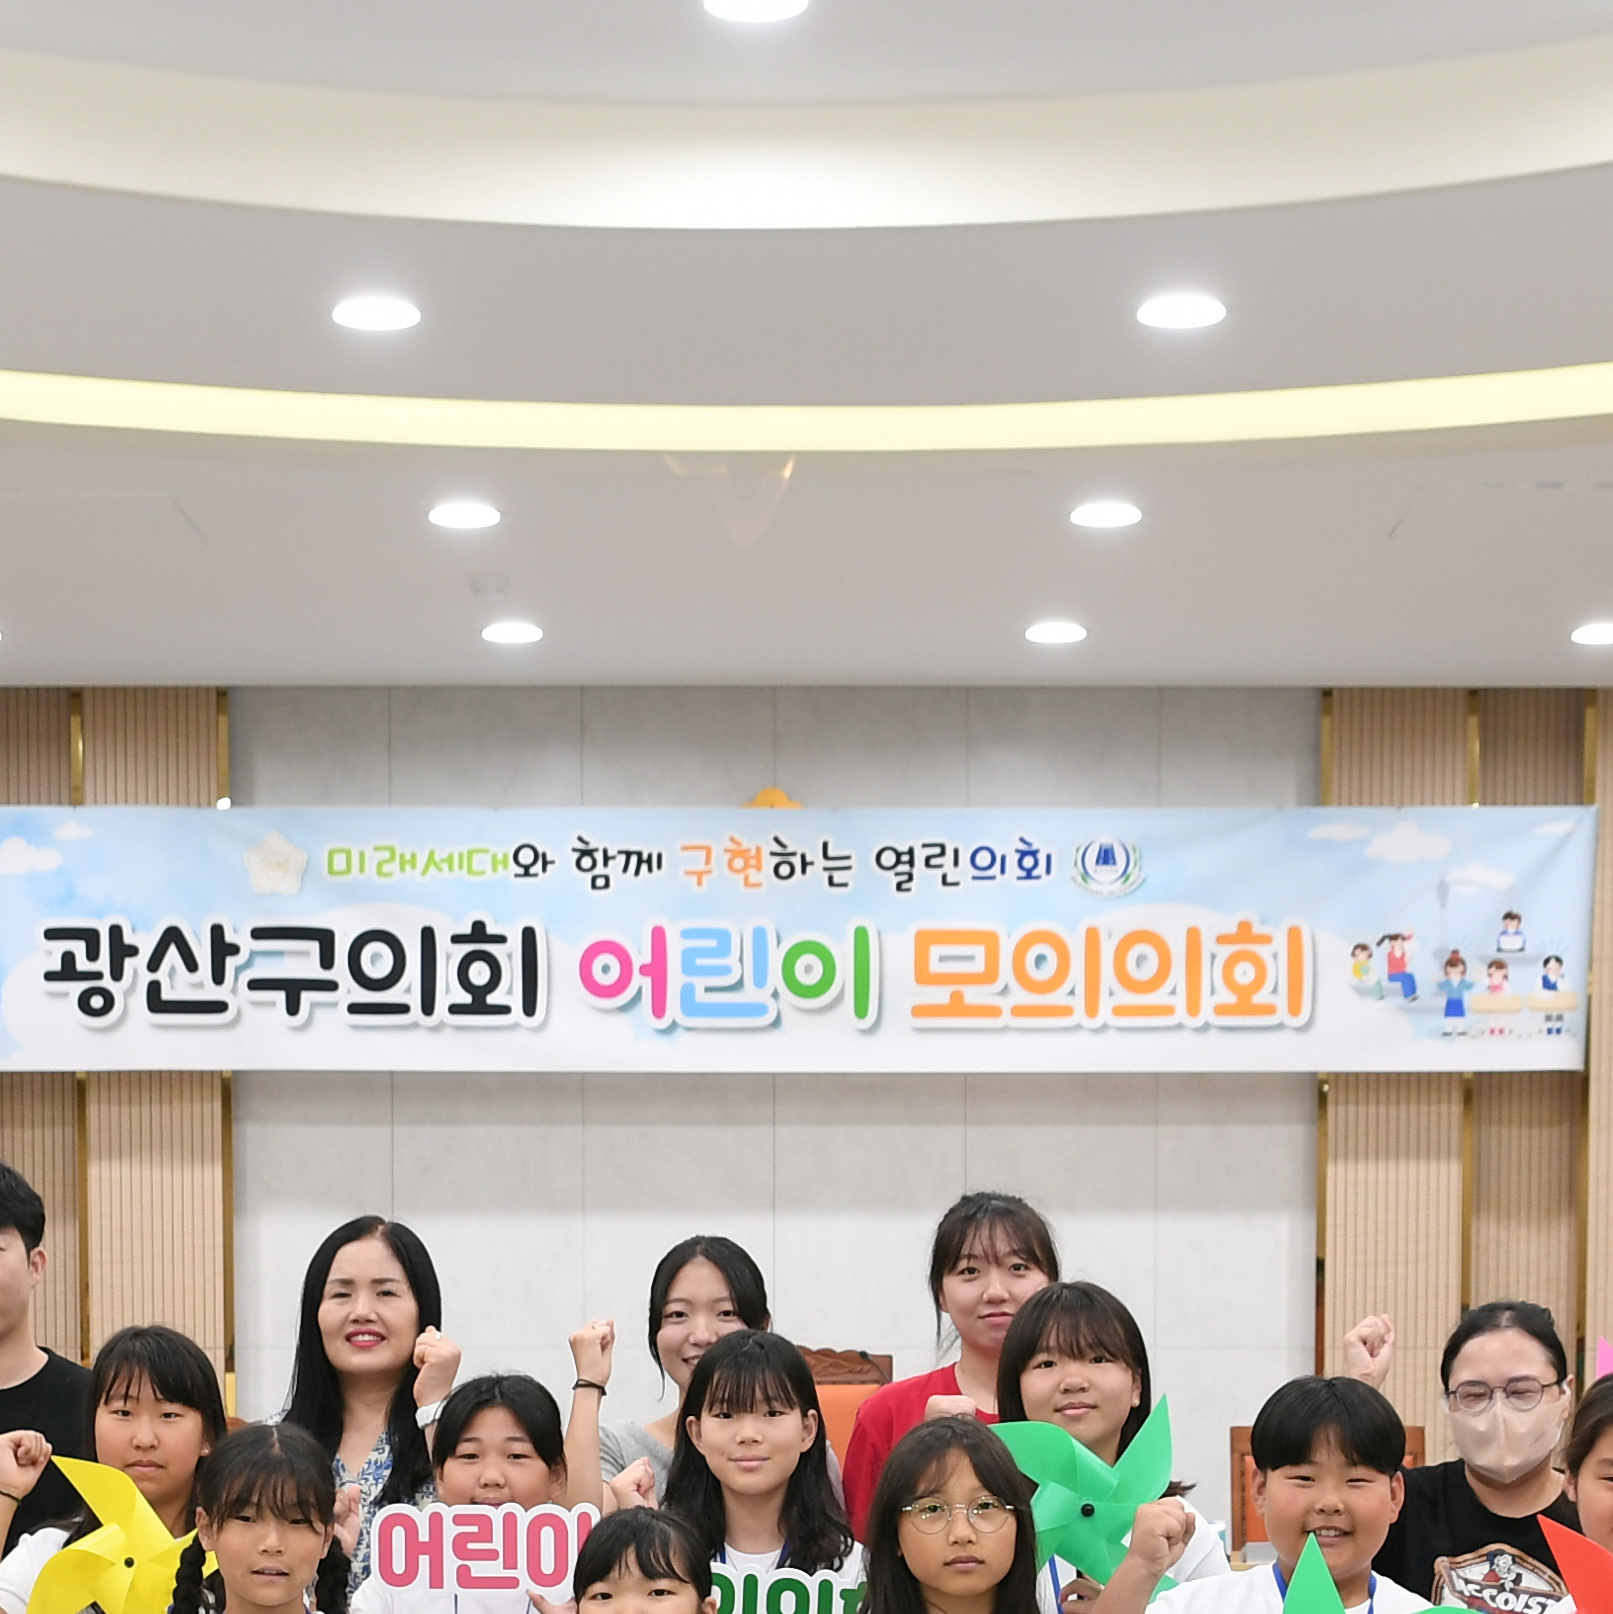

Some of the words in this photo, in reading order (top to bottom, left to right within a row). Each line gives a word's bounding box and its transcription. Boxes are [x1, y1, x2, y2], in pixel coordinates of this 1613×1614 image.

[326, 842, 556, 880] 미래세대와
[570, 834, 663, 891] 함께
[678, 834, 855, 890] 구현하는
[874, 835, 1053, 893] 열린의회
[42, 920, 538, 1018] 광산구의회
[578, 924, 871, 1020] 어린이
[910, 918, 1304, 1019] 모의의회
[377, 1510, 592, 1591] 어린이
